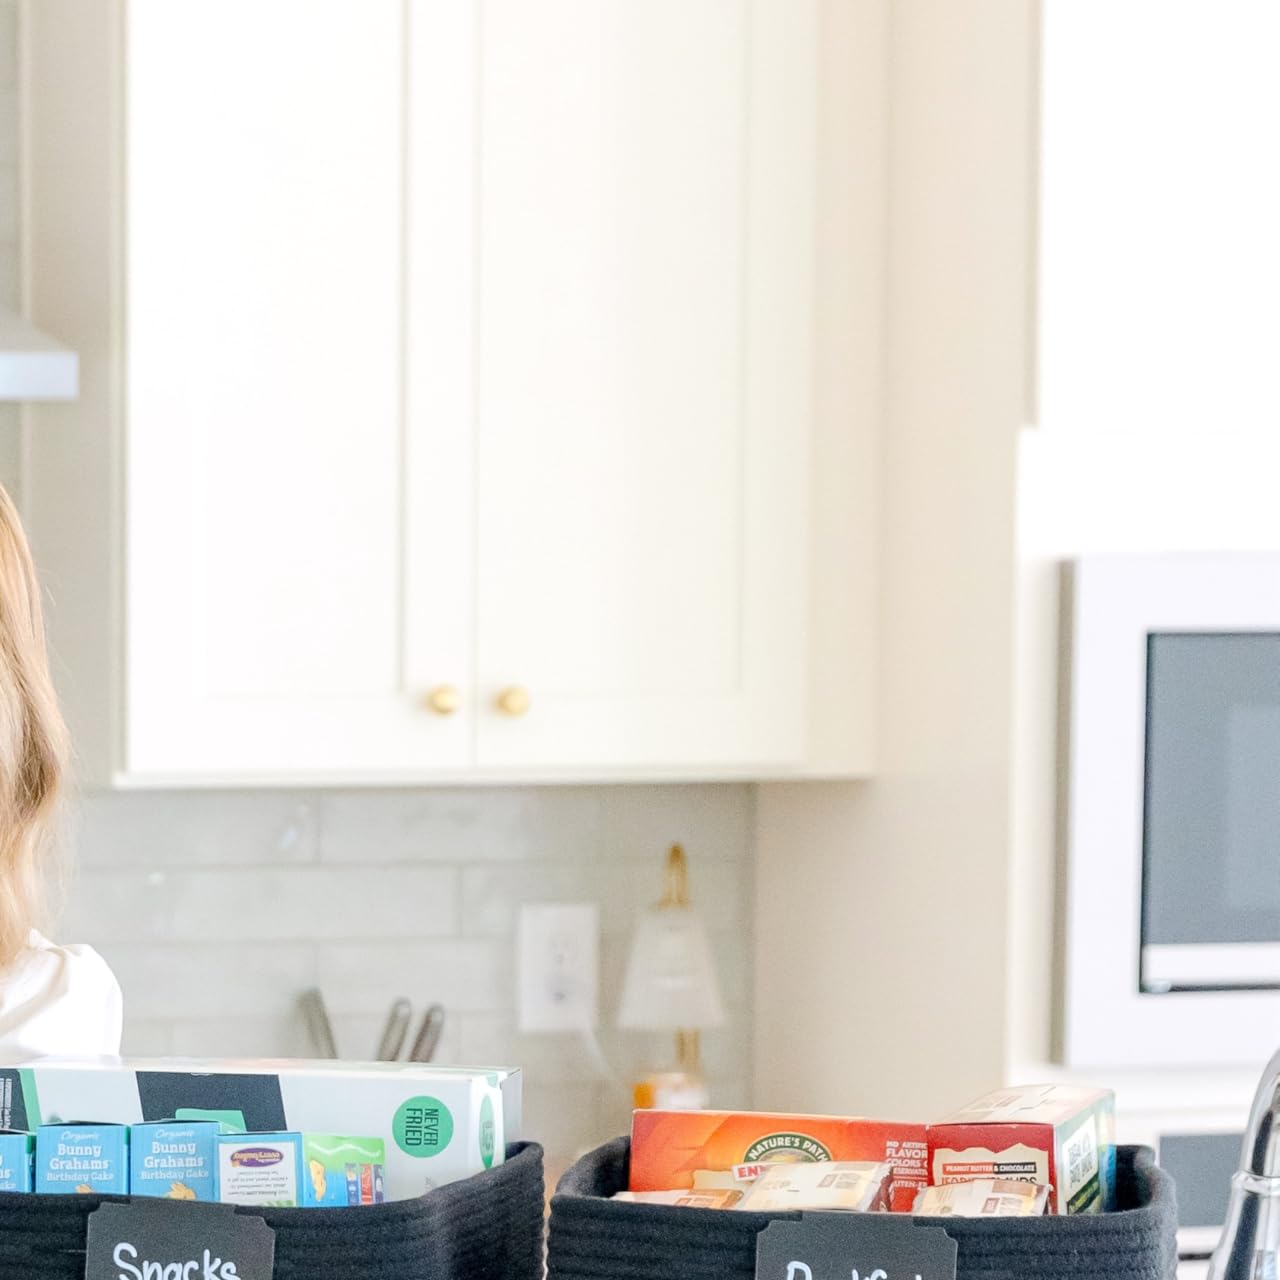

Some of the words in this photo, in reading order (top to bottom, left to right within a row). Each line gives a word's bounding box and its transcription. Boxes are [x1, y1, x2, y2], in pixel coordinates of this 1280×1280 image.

[405, 1108, 423, 1146] FRIED
[424, 1108, 439, 1146] NEVER
[58, 1144, 101, 1157] Bunny
[152, 1142, 196, 1154] Bunny
[748, 1137, 800, 1160] NATURE'S
[802, 1140, 829, 1161] PATH
[49, 1159, 109, 1170] Grahams
[144, 1157, 204, 1168] Grahams
[1000, 1164, 1035, 1172] CHOCOLATE
[47, 1172, 89, 1182] Birthday
[91, 1172, 113, 1181] Cake
[141, 1171, 184, 1180] Birthday
[186, 1170, 209, 1179] Cake
